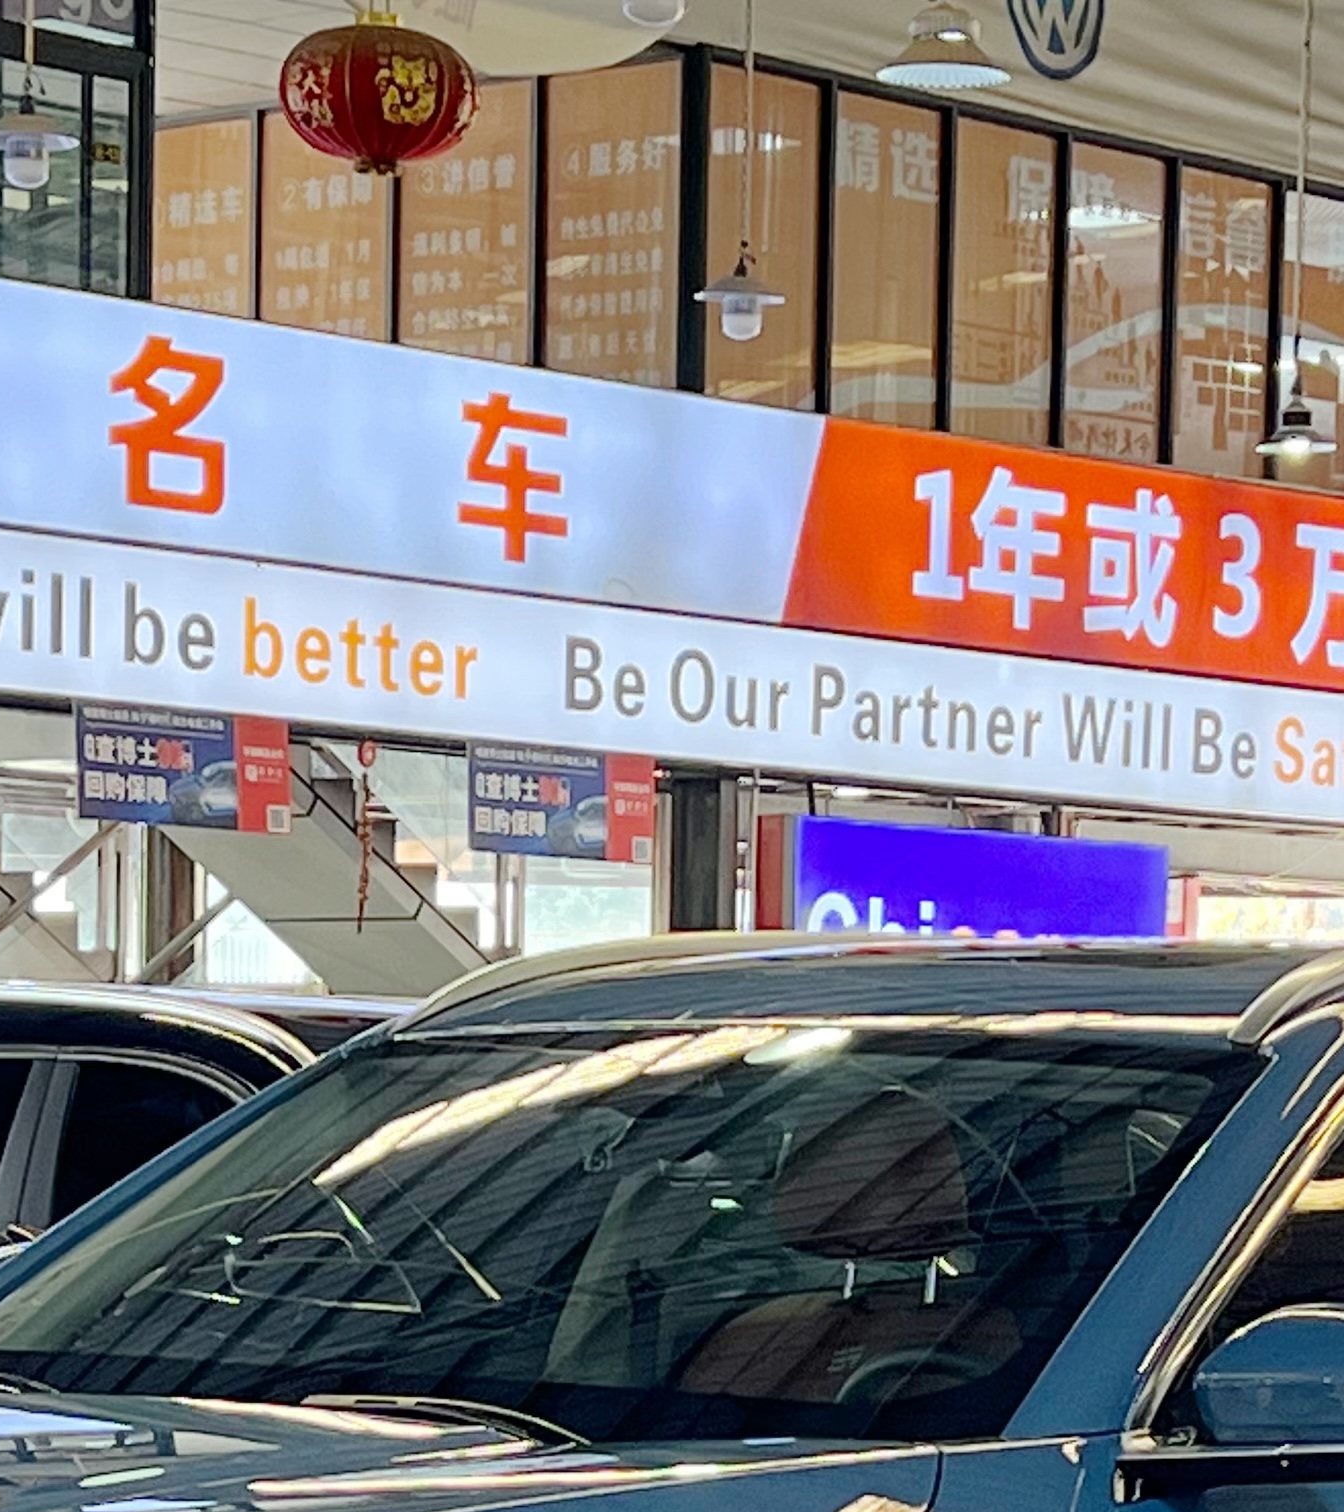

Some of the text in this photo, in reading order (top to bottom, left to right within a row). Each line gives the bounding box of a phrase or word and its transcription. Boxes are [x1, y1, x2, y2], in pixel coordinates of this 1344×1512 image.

[122, 581, 216, 671] be
[242, 596, 478, 700] better
[565, 634, 647, 716] Be
[669, 648, 790, 733] Our
[810, 664, 1043, 760] Partner
[1061, 693, 1172, 772] Will
[1191, 708, 1256, 780] Be
